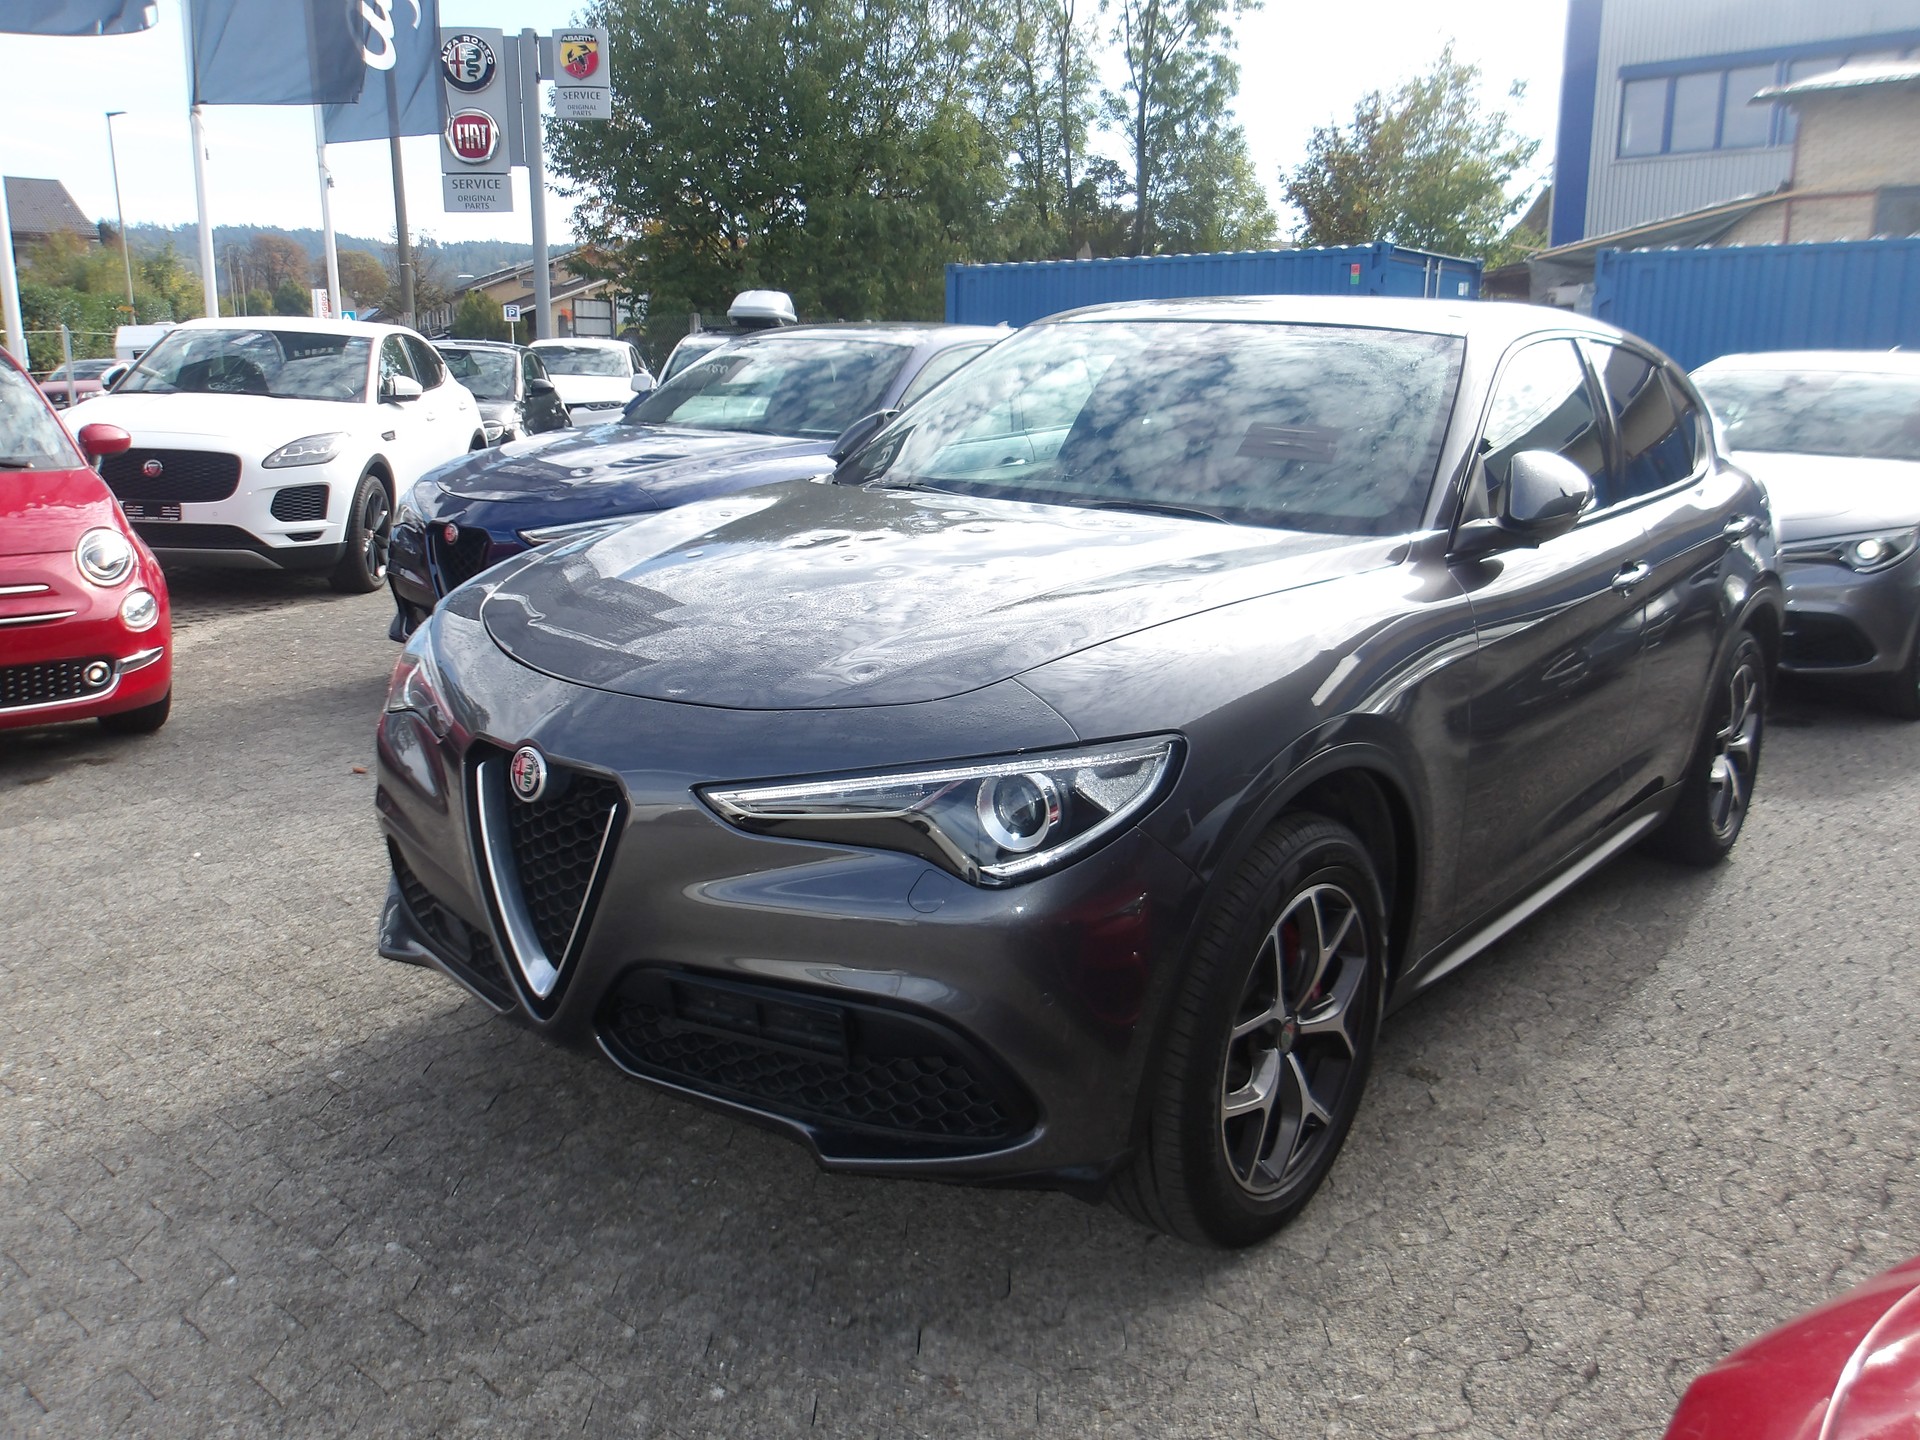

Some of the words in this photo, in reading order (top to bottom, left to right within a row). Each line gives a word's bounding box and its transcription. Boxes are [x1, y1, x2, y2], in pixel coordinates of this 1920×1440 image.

[441, 38, 459, 63] ALFA
[463, 35, 494, 65] ROMEO
[562, 91, 601, 100] SERVICE
[456, 123, 488, 150] FIAT
[452, 179, 501, 190] SERVICE
[457, 195, 496, 203] ORIGINAL
[465, 202, 490, 210] PARTS
